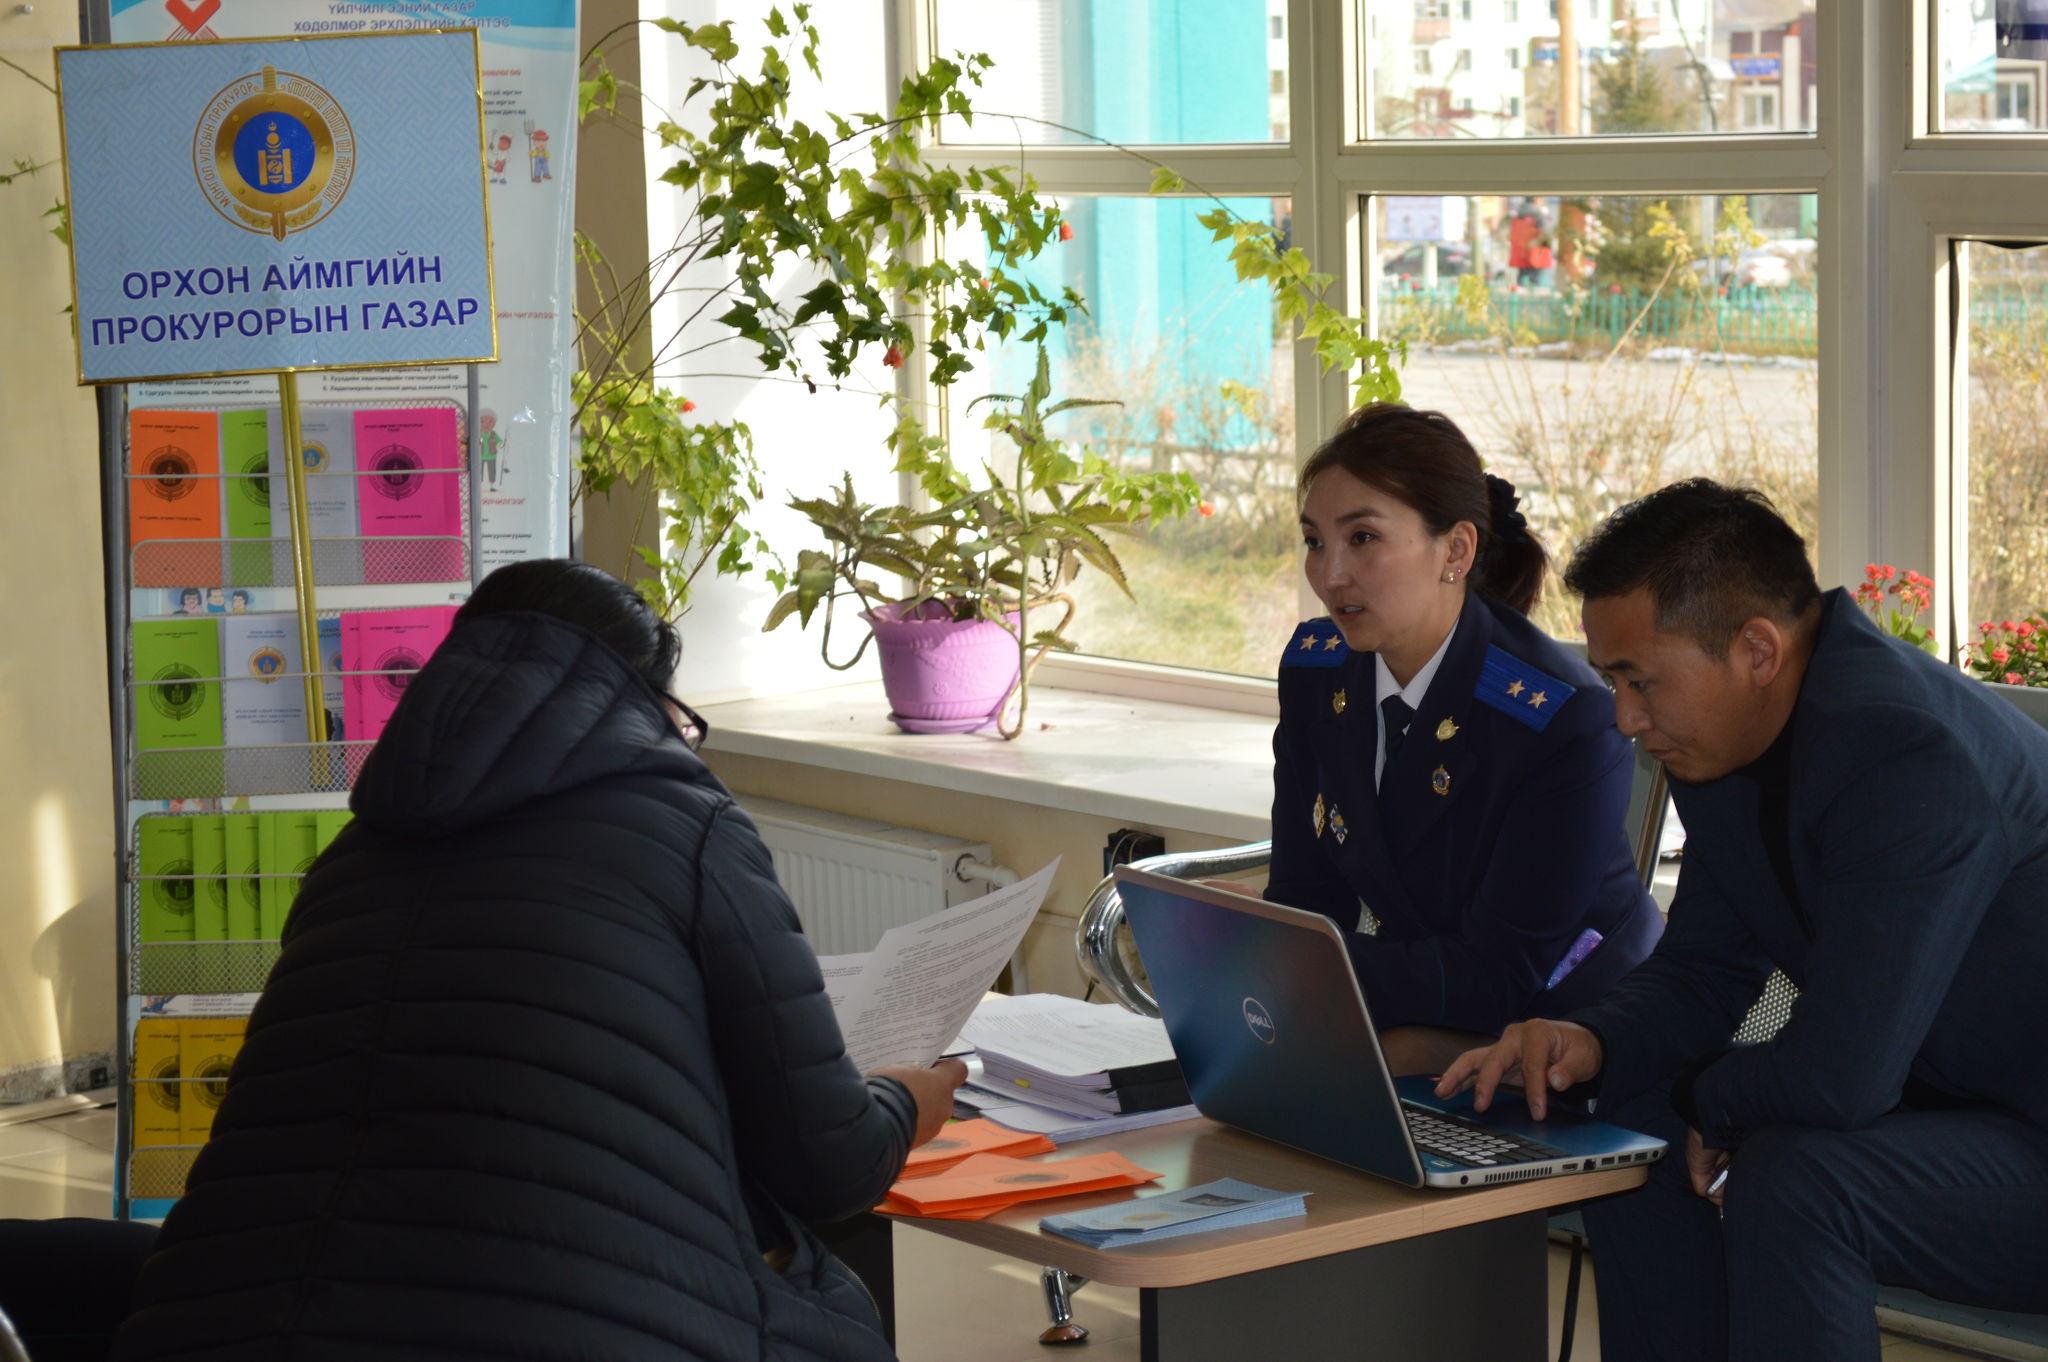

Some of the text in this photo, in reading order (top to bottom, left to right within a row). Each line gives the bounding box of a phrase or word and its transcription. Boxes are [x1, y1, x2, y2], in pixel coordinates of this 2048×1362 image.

[294, 20, 366, 32] ХӨДӨЛМӨР
[460, 17, 511, 29] ХЭЛТЭС
[435, 1, 476, 12] ГАЗАР
[200, 125, 215, 164] УЛСЫН
[201, 164, 232, 208] МОНГОЛ
[122, 250, 442, 300] ОРХОН АЙМГИЙН
[91, 297, 479, 346] ПРОКУРОРЫН ГАЗАР
[1247, 1012, 1271, 1029] DELL
